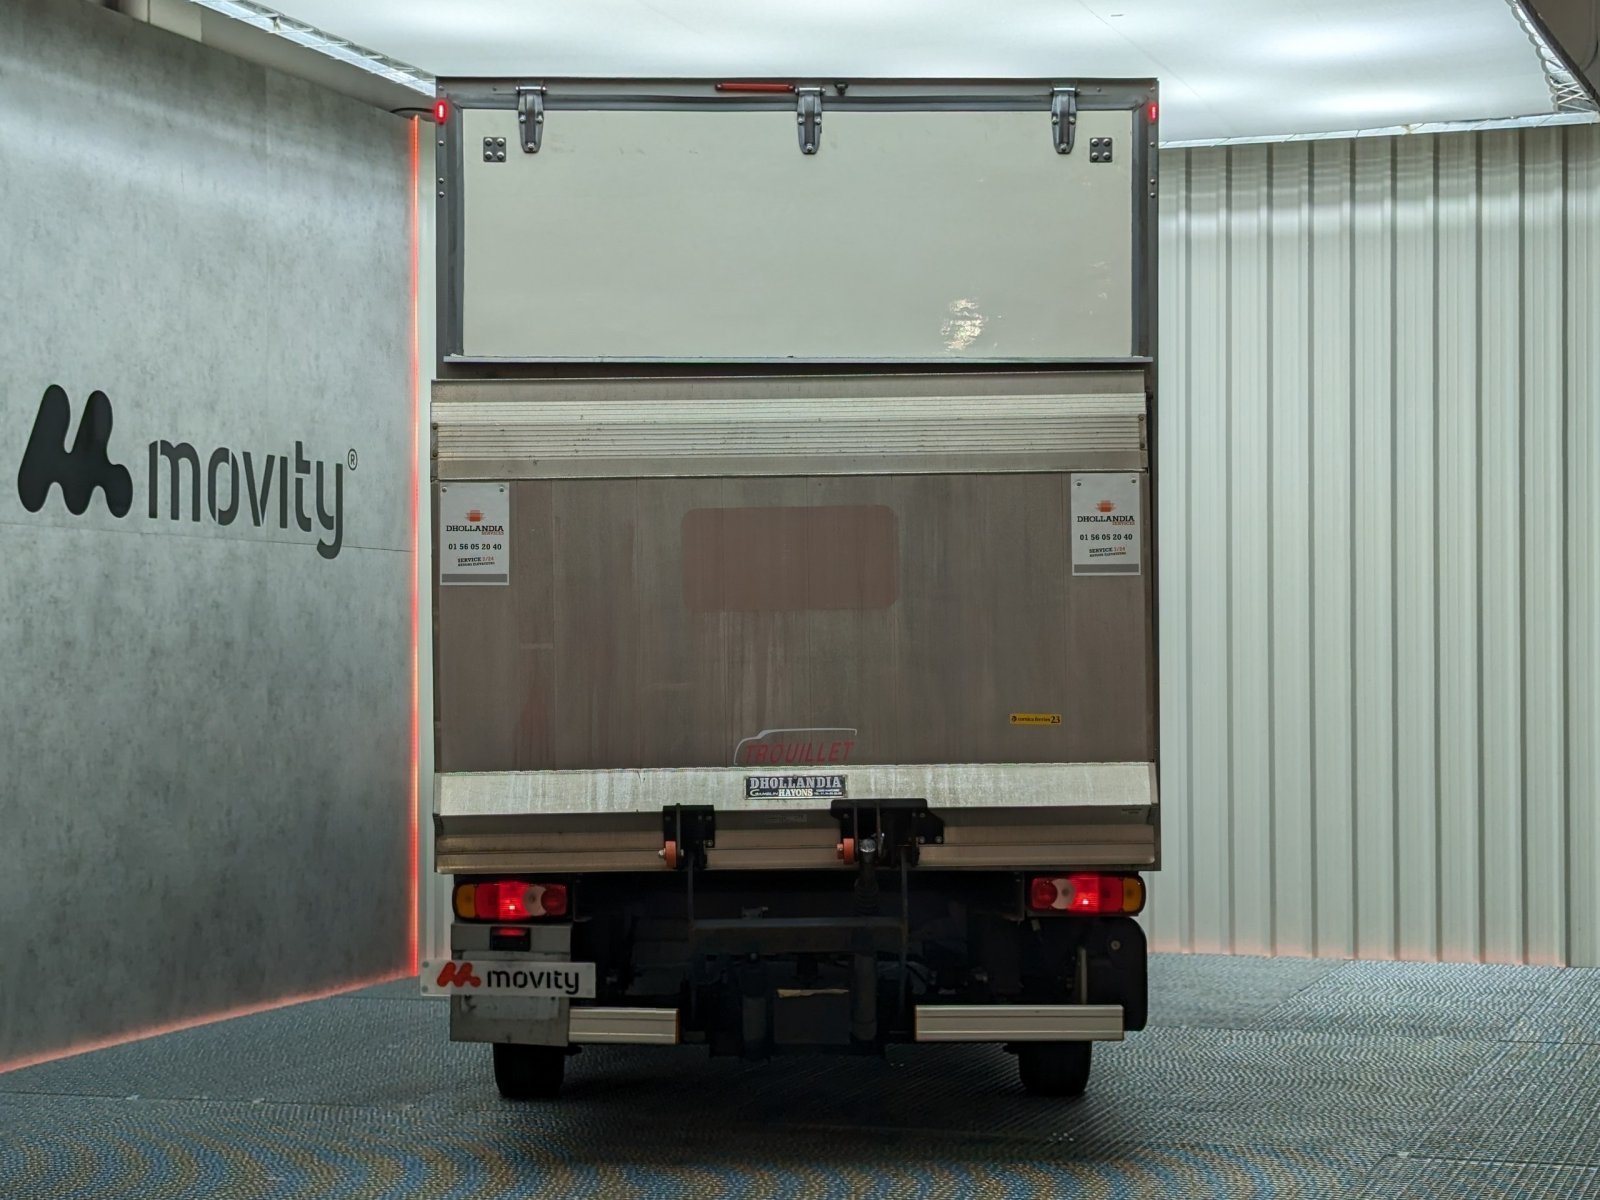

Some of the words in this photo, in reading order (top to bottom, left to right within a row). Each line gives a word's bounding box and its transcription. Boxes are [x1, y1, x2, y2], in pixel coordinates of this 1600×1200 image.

[148, 440, 344, 560] movity
[1050, 716, 1060, 724] 23
[745, 741, 854, 764] TROUILLET
[750, 777, 842, 789] DHOLLANDIA
[778, 789, 814, 797] HAYONS
[487, 970, 579, 995] movity
